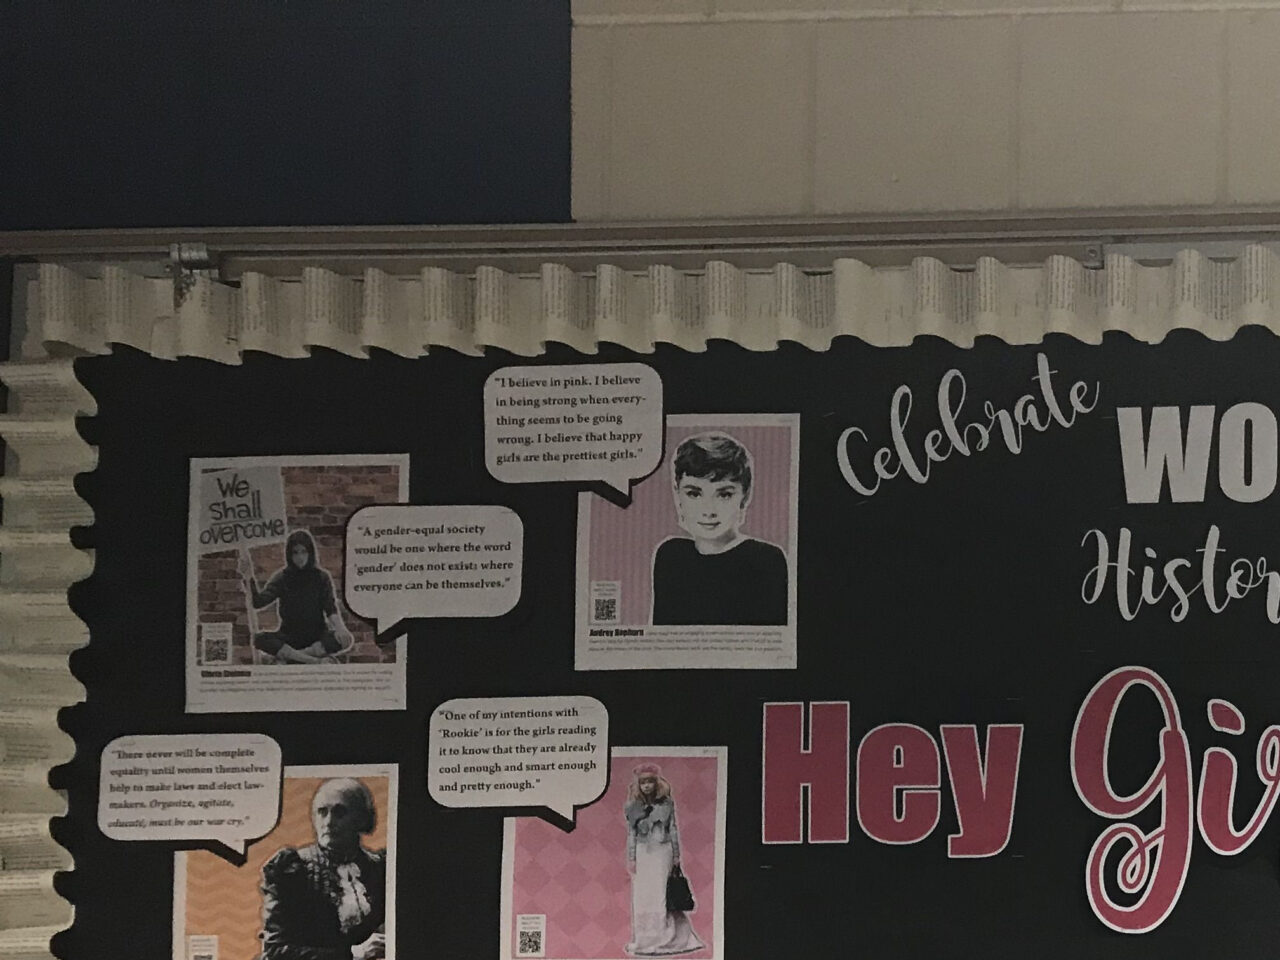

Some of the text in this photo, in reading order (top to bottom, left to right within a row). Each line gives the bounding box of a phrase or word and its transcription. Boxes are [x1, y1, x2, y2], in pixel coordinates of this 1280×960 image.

[837, 352, 1100, 495] Celebrate
[496, 452, 520, 465] girls
[522, 454, 539, 462] are
[542, 451, 560, 461] the
[562, 451, 607, 463] prettiest
[216, 474, 250, 498] We
[438, 759, 596, 775] cool enough and smart enough
[762, 701, 1024, 858] Hey
